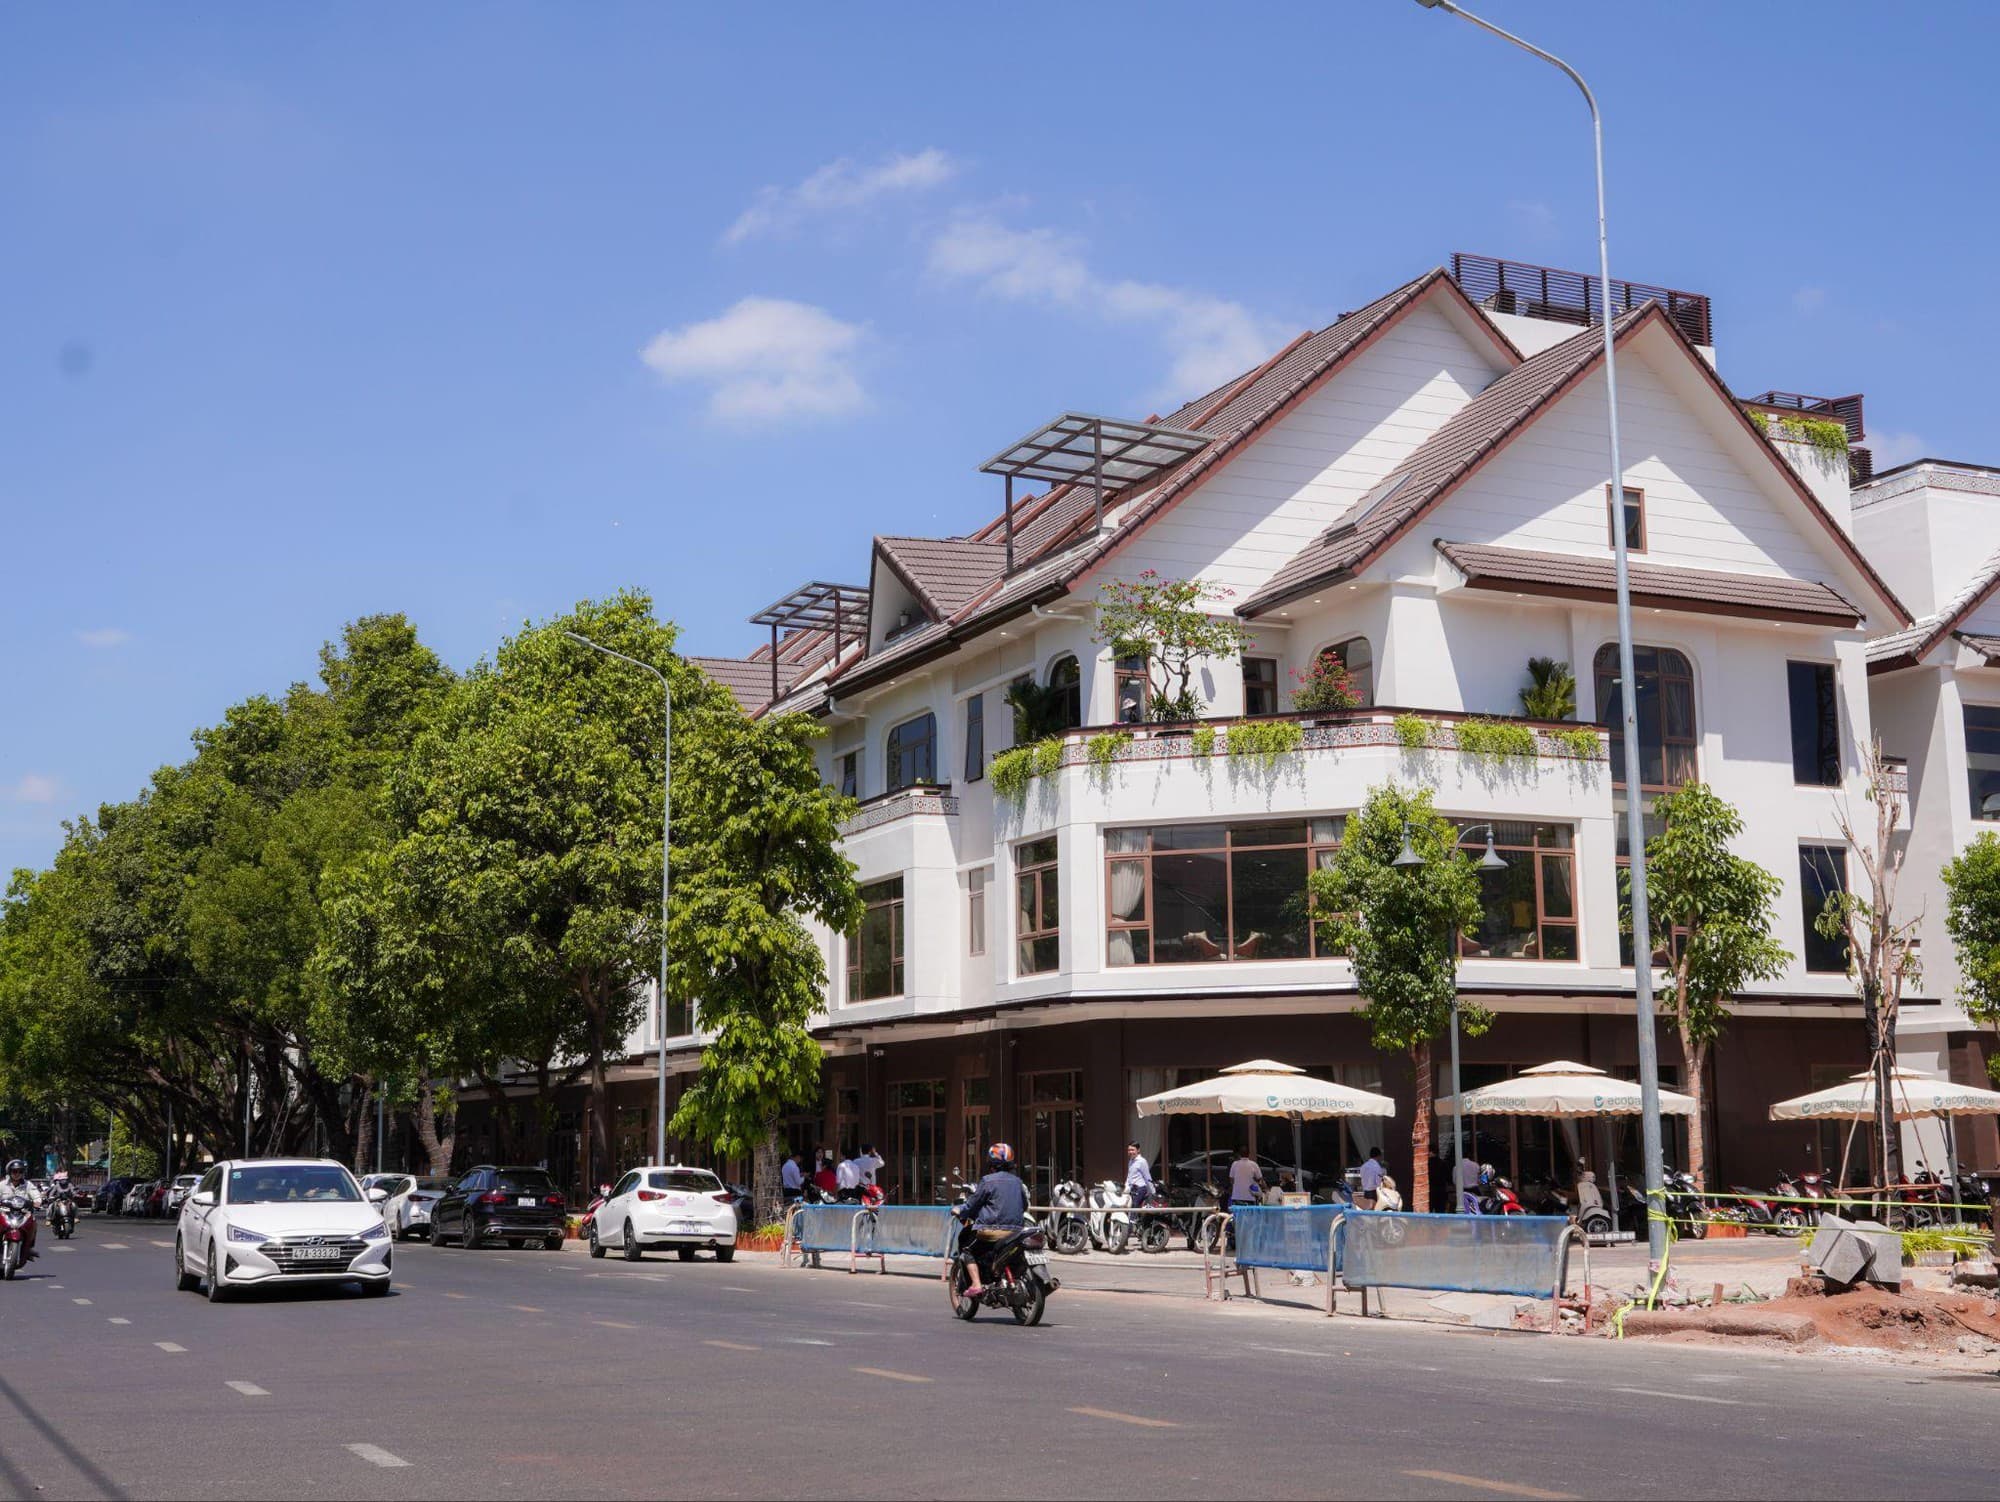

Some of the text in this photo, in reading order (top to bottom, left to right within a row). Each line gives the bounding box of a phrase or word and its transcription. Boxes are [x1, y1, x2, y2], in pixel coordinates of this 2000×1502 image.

[1283, 1096, 1354, 1109] ecopalace
[1475, 1096, 1527, 1107] ecopalace
[1607, 1096, 1664, 1107] ecopae
[1813, 1098, 1868, 1111] ecopalace
[1945, 1095, 1994, 1106] ecopalace
